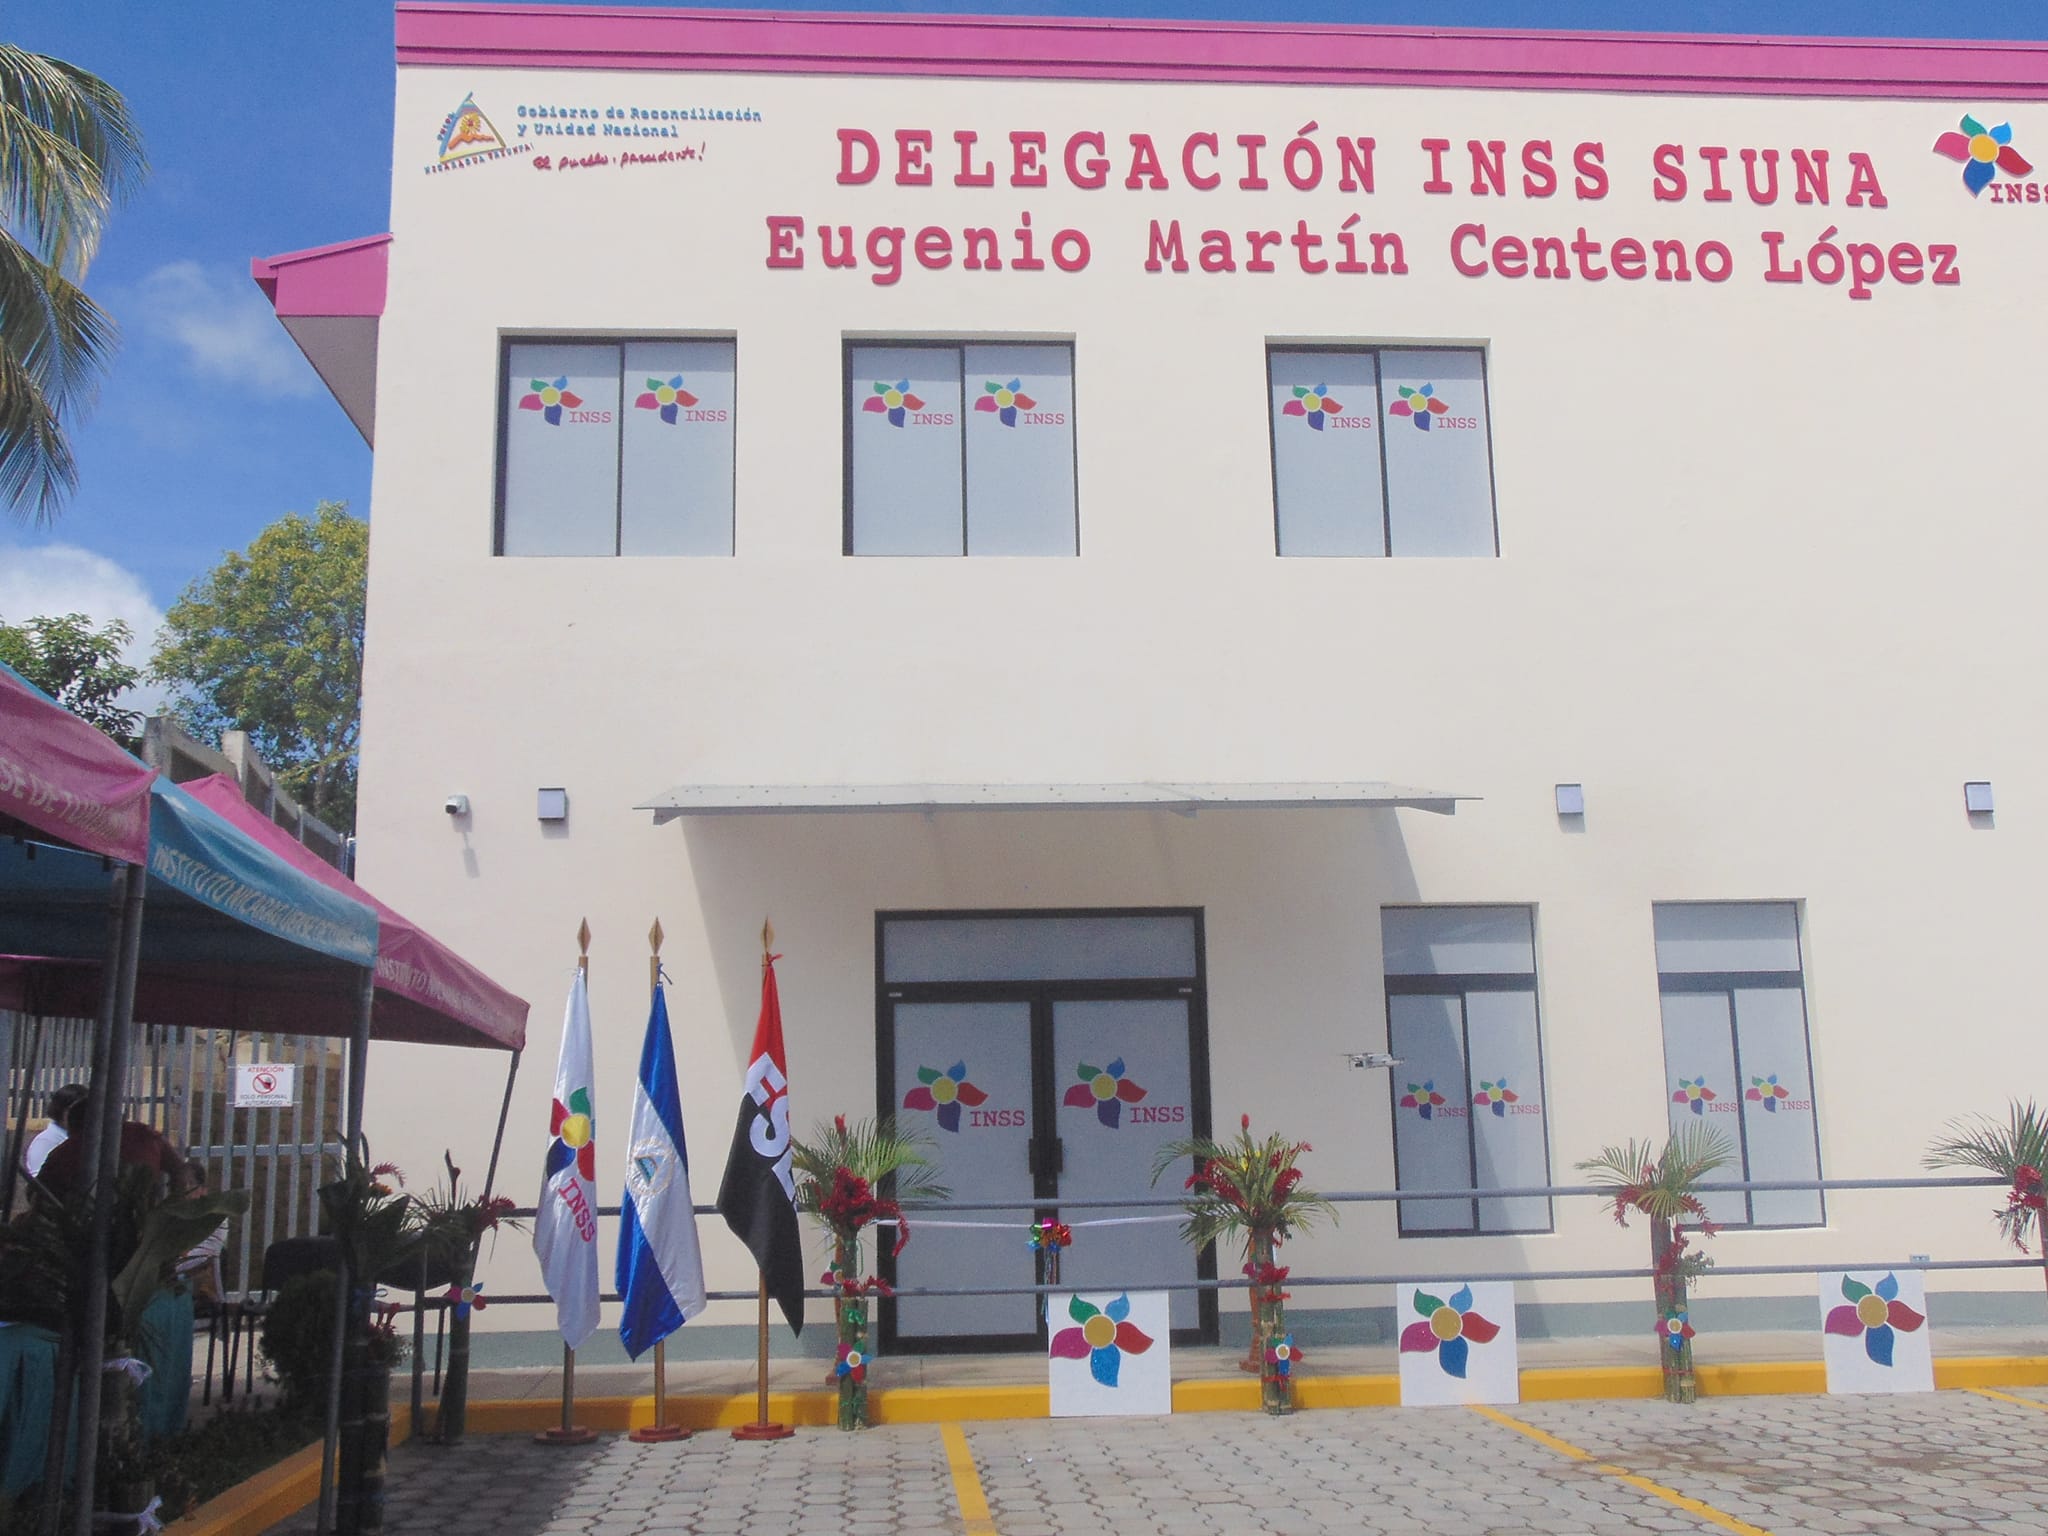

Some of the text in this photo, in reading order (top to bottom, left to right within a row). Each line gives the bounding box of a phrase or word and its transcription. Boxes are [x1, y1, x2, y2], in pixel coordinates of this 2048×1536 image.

[517, 105, 762, 122] Gobierno de Reconciliación
[517, 122, 679, 138] y Unidad Nacional
[836, 121, 1888, 209] DELEGACIÓN INSS SIUNA
[766, 212, 1961, 300] Eugenio Martín Centeno López
[569, 411, 612, 424] INSS
[685, 410, 727, 422] INSS
[912, 413, 954, 425] INSS
[1024, 412, 1065, 425] INSS
[1331, 416, 1372, 429] INSS
[1438, 417, 1477, 429] INSS
[1437, 1106, 1468, 1118] INSS
[1509, 1104, 1541, 1115] INSS
[1708, 1102, 1738, 1113] INSS
[1781, 1100, 1811, 1111] INSS
[969, 1110, 1026, 1127] INSS
[1130, 1106, 1185, 1123] INSS
[745, 1051, 799, 1203] FSL
[557, 1177, 595, 1243] INSS
